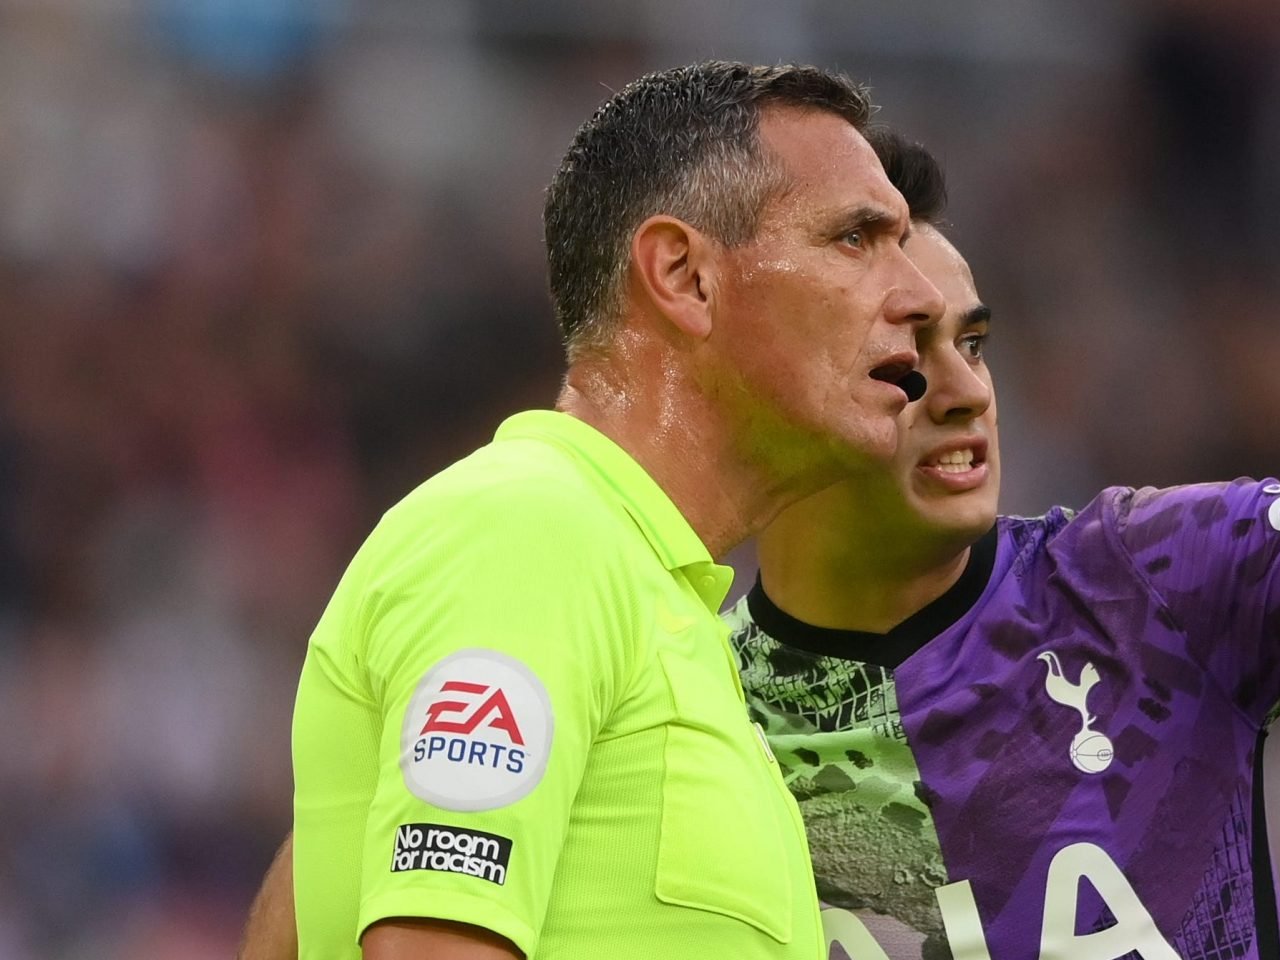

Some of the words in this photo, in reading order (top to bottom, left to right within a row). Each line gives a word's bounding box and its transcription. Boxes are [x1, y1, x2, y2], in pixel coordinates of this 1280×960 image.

[419, 681, 525, 746] EA
[414, 736, 525, 774] SPORTS
[394, 825, 423, 849] No
[426, 829, 500, 860] room
[391, 848, 420, 871] for
[420, 849, 506, 885] racism
